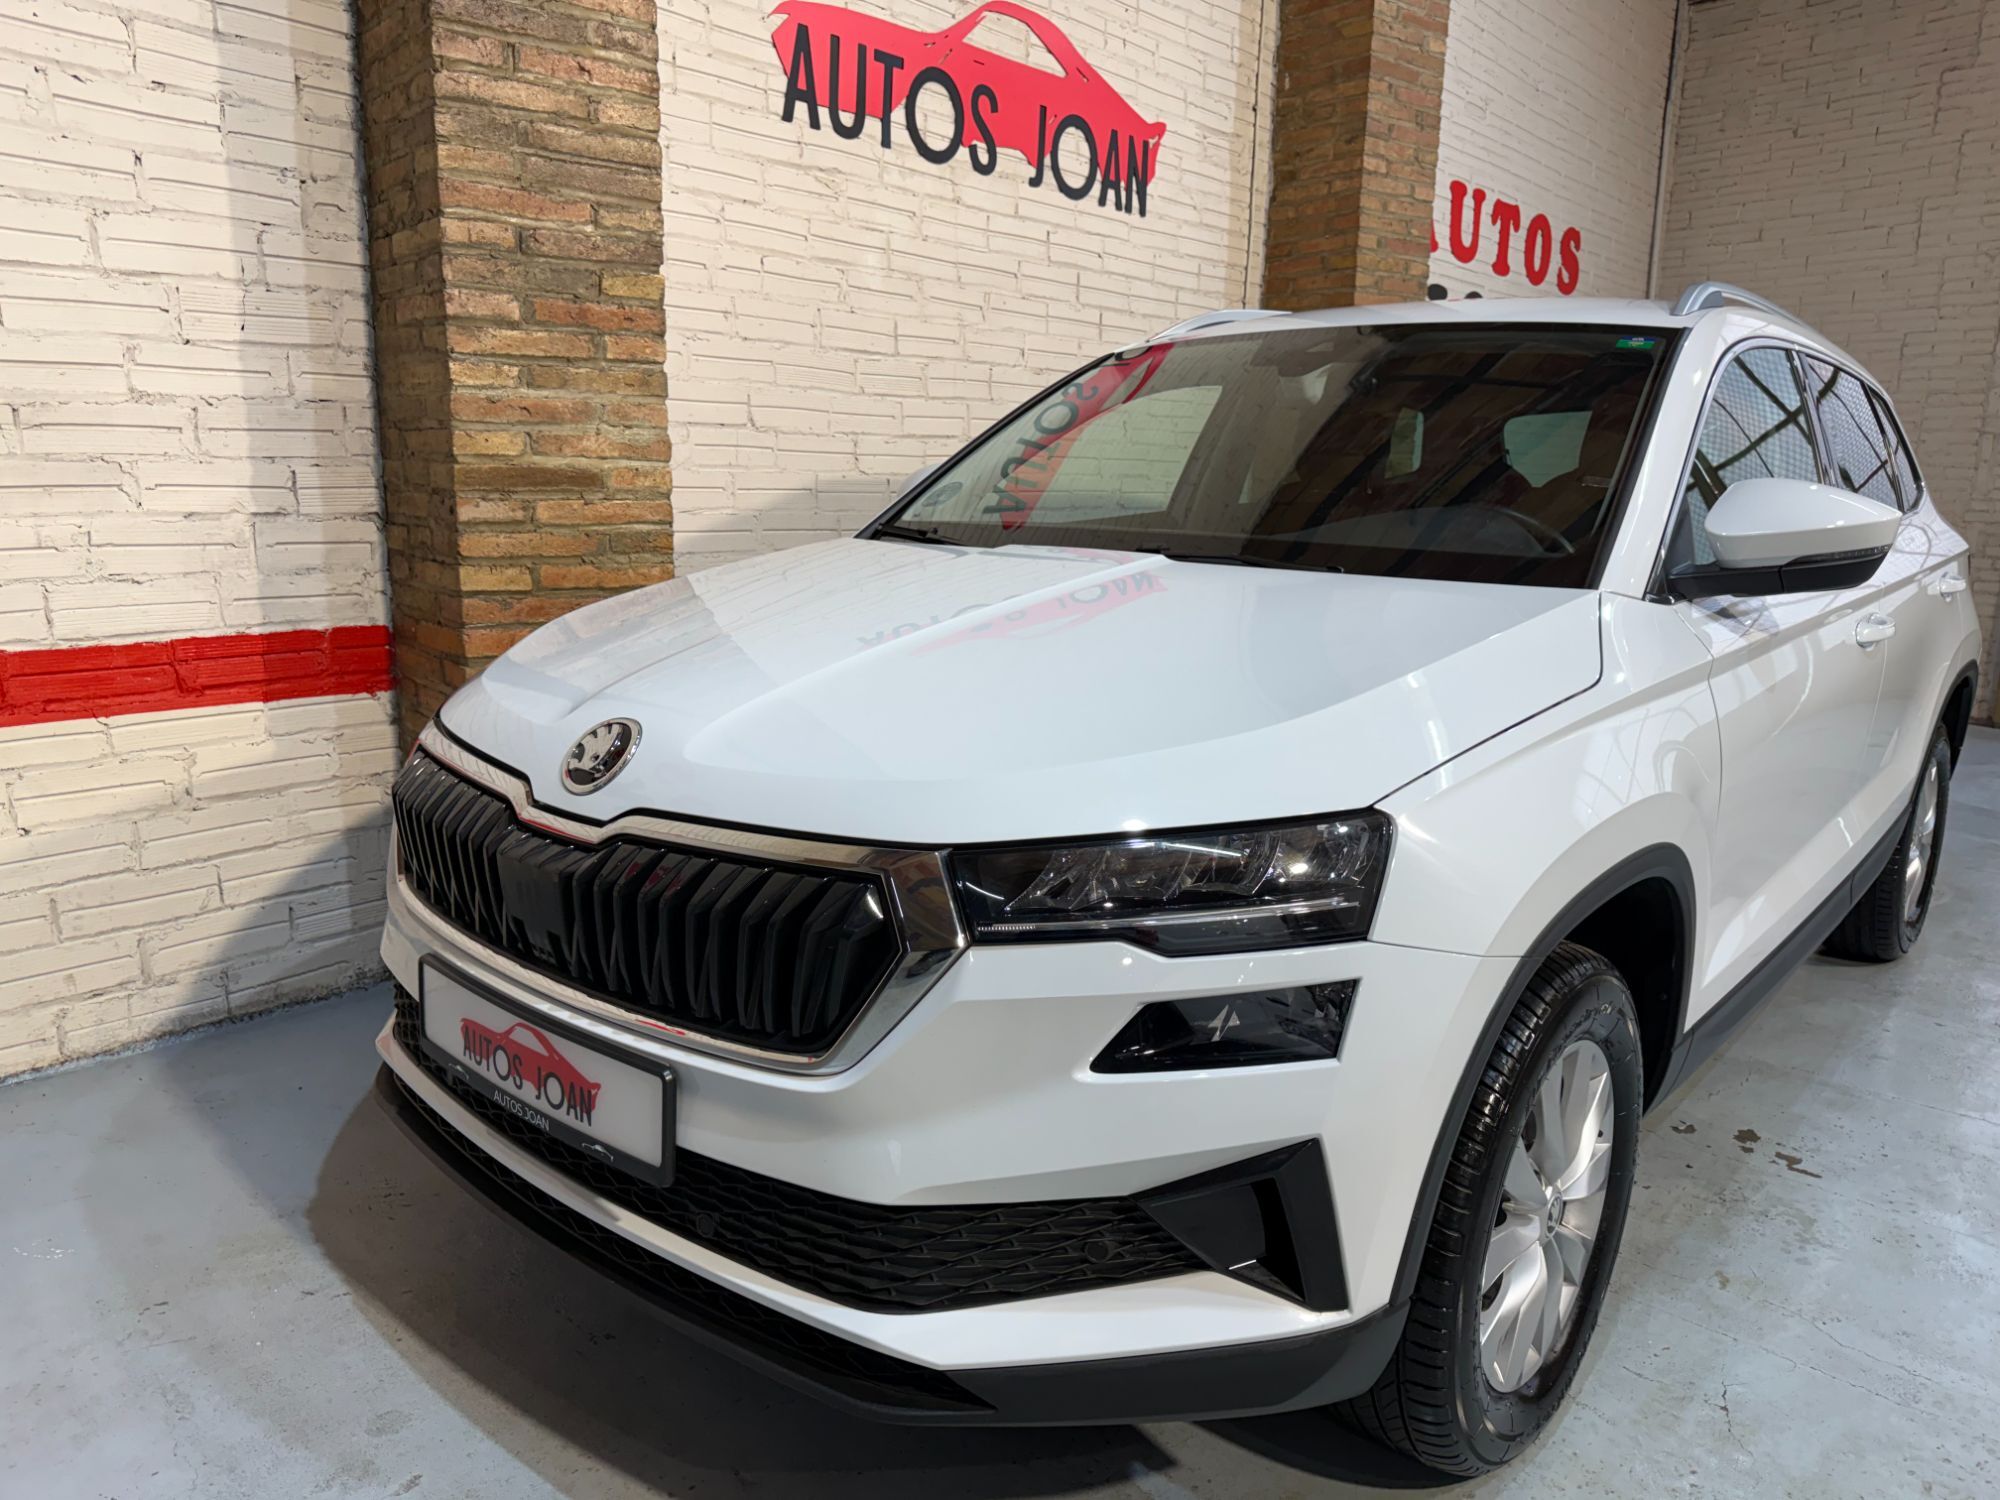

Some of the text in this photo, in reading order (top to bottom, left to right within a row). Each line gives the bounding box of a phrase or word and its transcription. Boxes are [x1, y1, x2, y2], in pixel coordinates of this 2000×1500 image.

[781, 22, 1148, 217] AUTOS JOAN
[1429, 180, 1581, 295] UTOS
[463, 1025, 592, 1127] AUTOS JOAN
[493, 1089, 550, 1132] AUTOS JOAN
